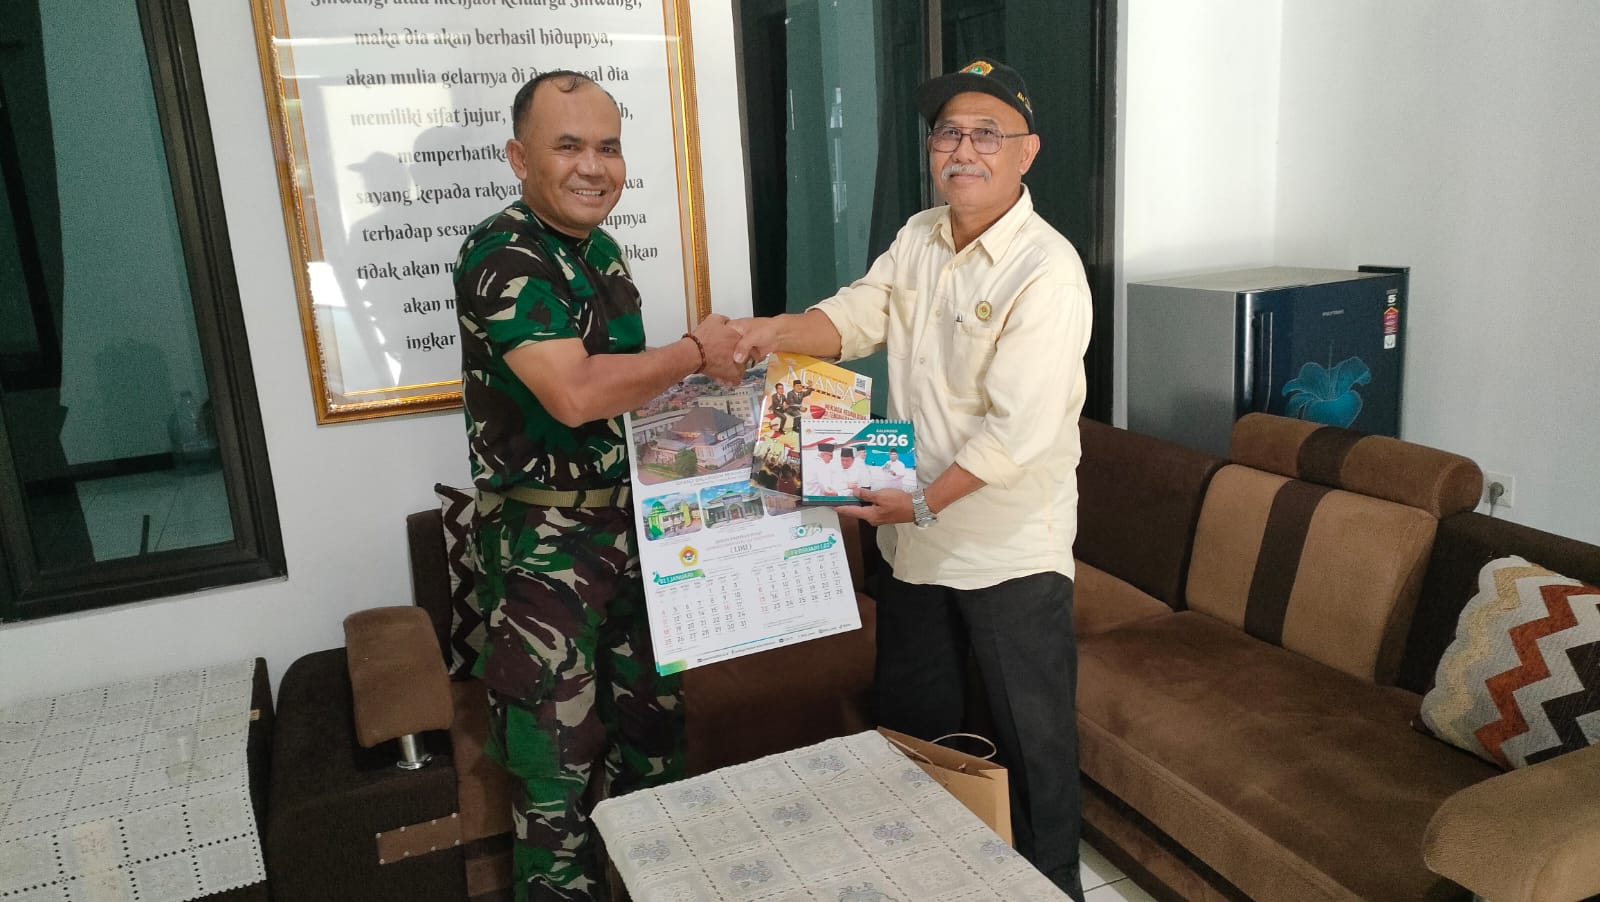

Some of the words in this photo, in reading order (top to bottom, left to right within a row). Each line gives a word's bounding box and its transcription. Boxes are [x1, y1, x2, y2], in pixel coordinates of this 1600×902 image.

[354, 28, 400, 48] maka
[404, 28, 429, 45] dia
[433, 28, 471, 48] akan
[475, 28, 536, 46] berhasil
[540, 28, 613, 49] hidupnya,
[346, 69, 386, 88] akan
[391, 68, 436, 85] mulia
[441, 68, 507, 88] gelarnya
[511, 67, 526, 83] di
[607, 66, 629, 81] dia
[351, 108, 422, 126] memiliki
[426, 107, 460, 127] sifat
[464, 108, 506, 127] jujur,
[398, 144, 507, 166] memperhatika
[357, 189, 412, 207] sayang
[415, 183, 470, 204] kepada
[362, 223, 433, 242] terhadap
[357, 262, 402, 280] tidak
[402, 260, 440, 278] akan
[403, 297, 440, 315] akan
[1388, 295, 1397, 303] 5
[406, 332, 456, 352] ingkar
[866, 433, 909, 447] 2026
